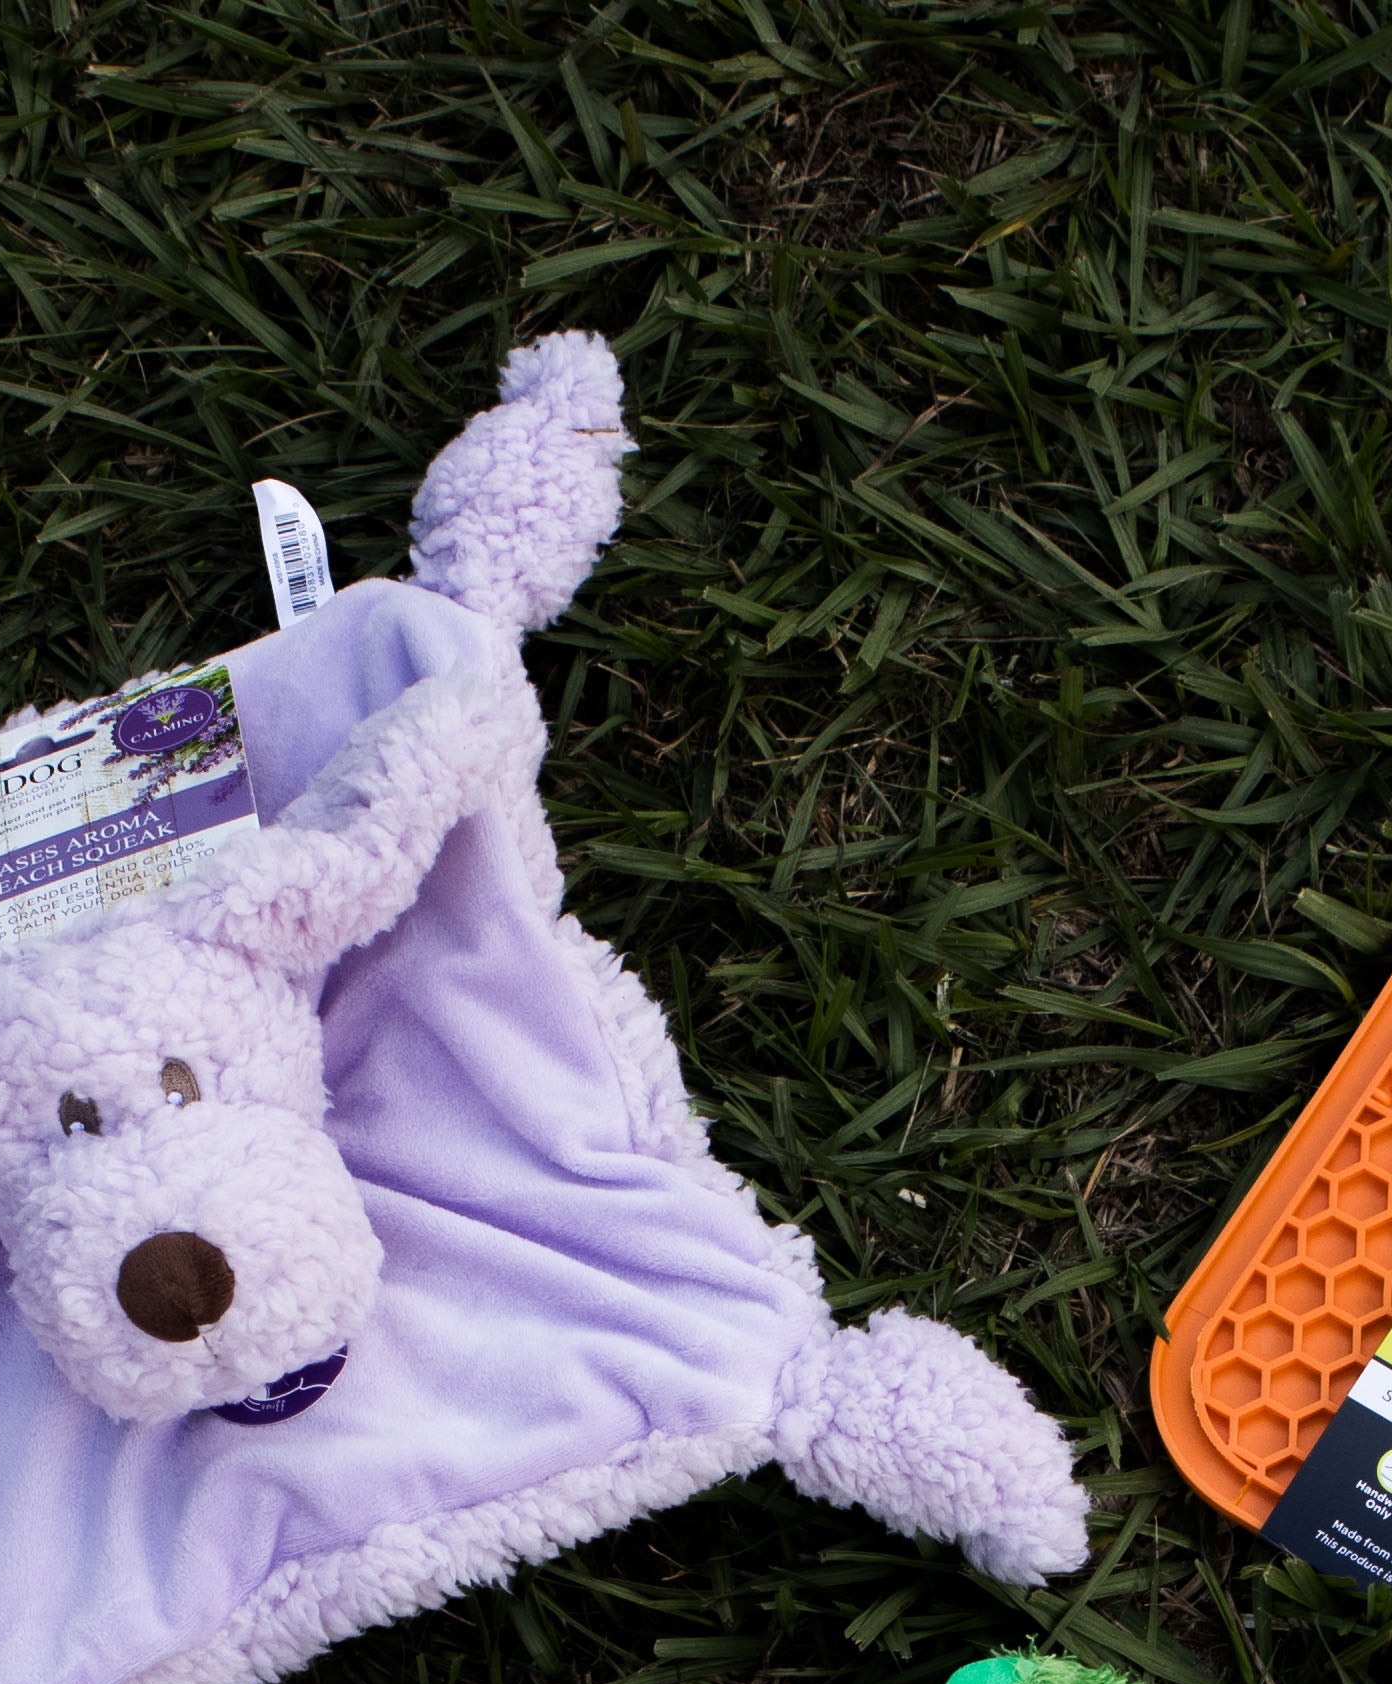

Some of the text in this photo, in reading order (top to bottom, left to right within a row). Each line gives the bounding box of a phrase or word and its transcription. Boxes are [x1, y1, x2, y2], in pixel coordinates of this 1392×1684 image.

[129, 711, 205, 745] CALMING
[10, 783, 64, 809] DELIVERY
[25, 805, 43, 817] and
[49, 797, 65, 810] pet
[73, 776, 122, 802] approved
[44, 811, 51, 819] in
[57, 800, 79, 815] pets
[66, 810, 160, 852] AROMA
[71, 821, 175, 867] SQUEAK
[85, 861, 136, 885] BLEND
[143, 851, 162, 866] OF
[167, 839, 204, 857] 100%
[7, 900, 57, 924] GRADE
[65, 870, 151, 904] ESSENTIAL
[156, 855, 191, 872] OILS
[196, 847, 214, 858] TO
[12, 913, 56, 935] CALM
[61, 894, 106, 916] YOUR
[110, 883, 144, 900] DOG
[260, 1399, 286, 1413] sniff
[1365, 1498, 1391, 1519] Only
[1314, 1529, 1338, 1549] This
[1335, 1545, 1383, 1576] product
[1331, 1519, 1362, 1542] Made
[1363, 1537, 1390, 1560] from
